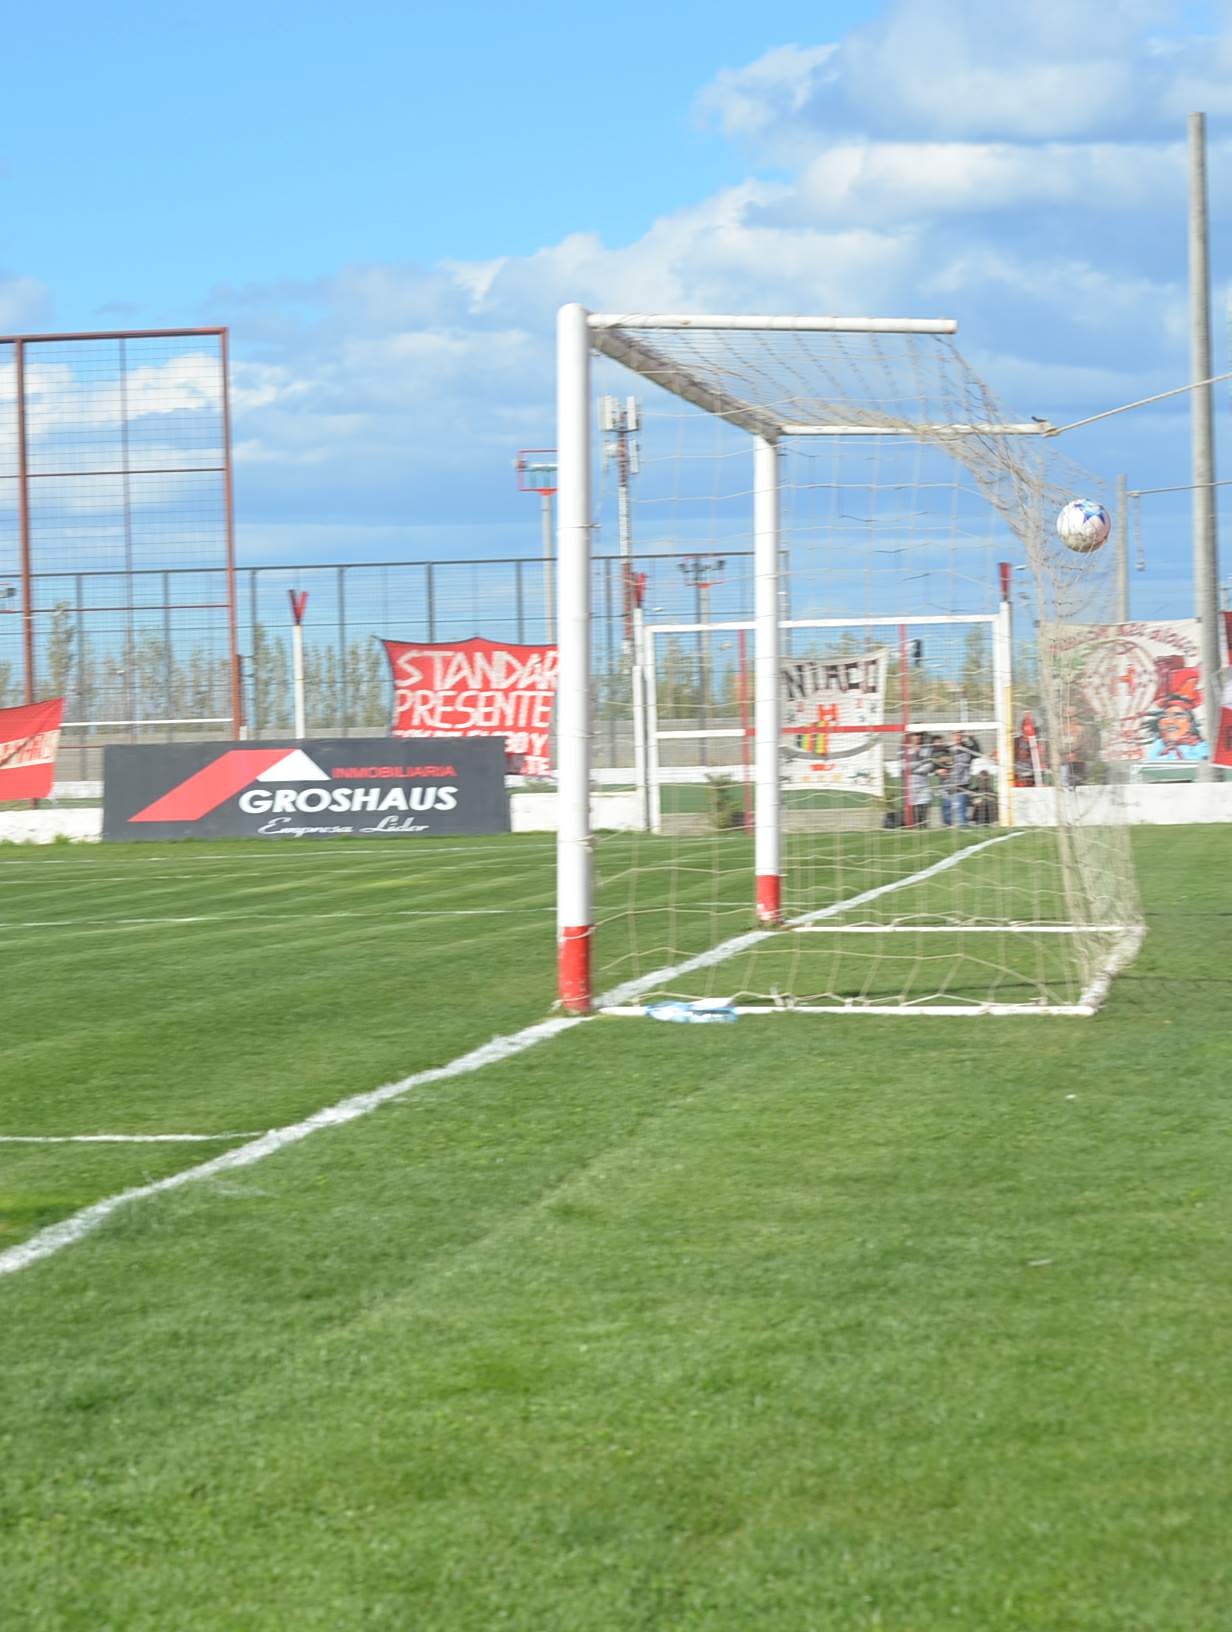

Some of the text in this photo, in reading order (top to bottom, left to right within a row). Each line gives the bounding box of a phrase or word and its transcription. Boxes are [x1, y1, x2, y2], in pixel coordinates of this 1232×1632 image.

[392, 689, 556, 729] PRESENTE
[331, 765, 458, 779] INMOBILIARIA
[238, 786, 459, 814] GROSHAUS
[257, 817, 354, 837] Empresa
